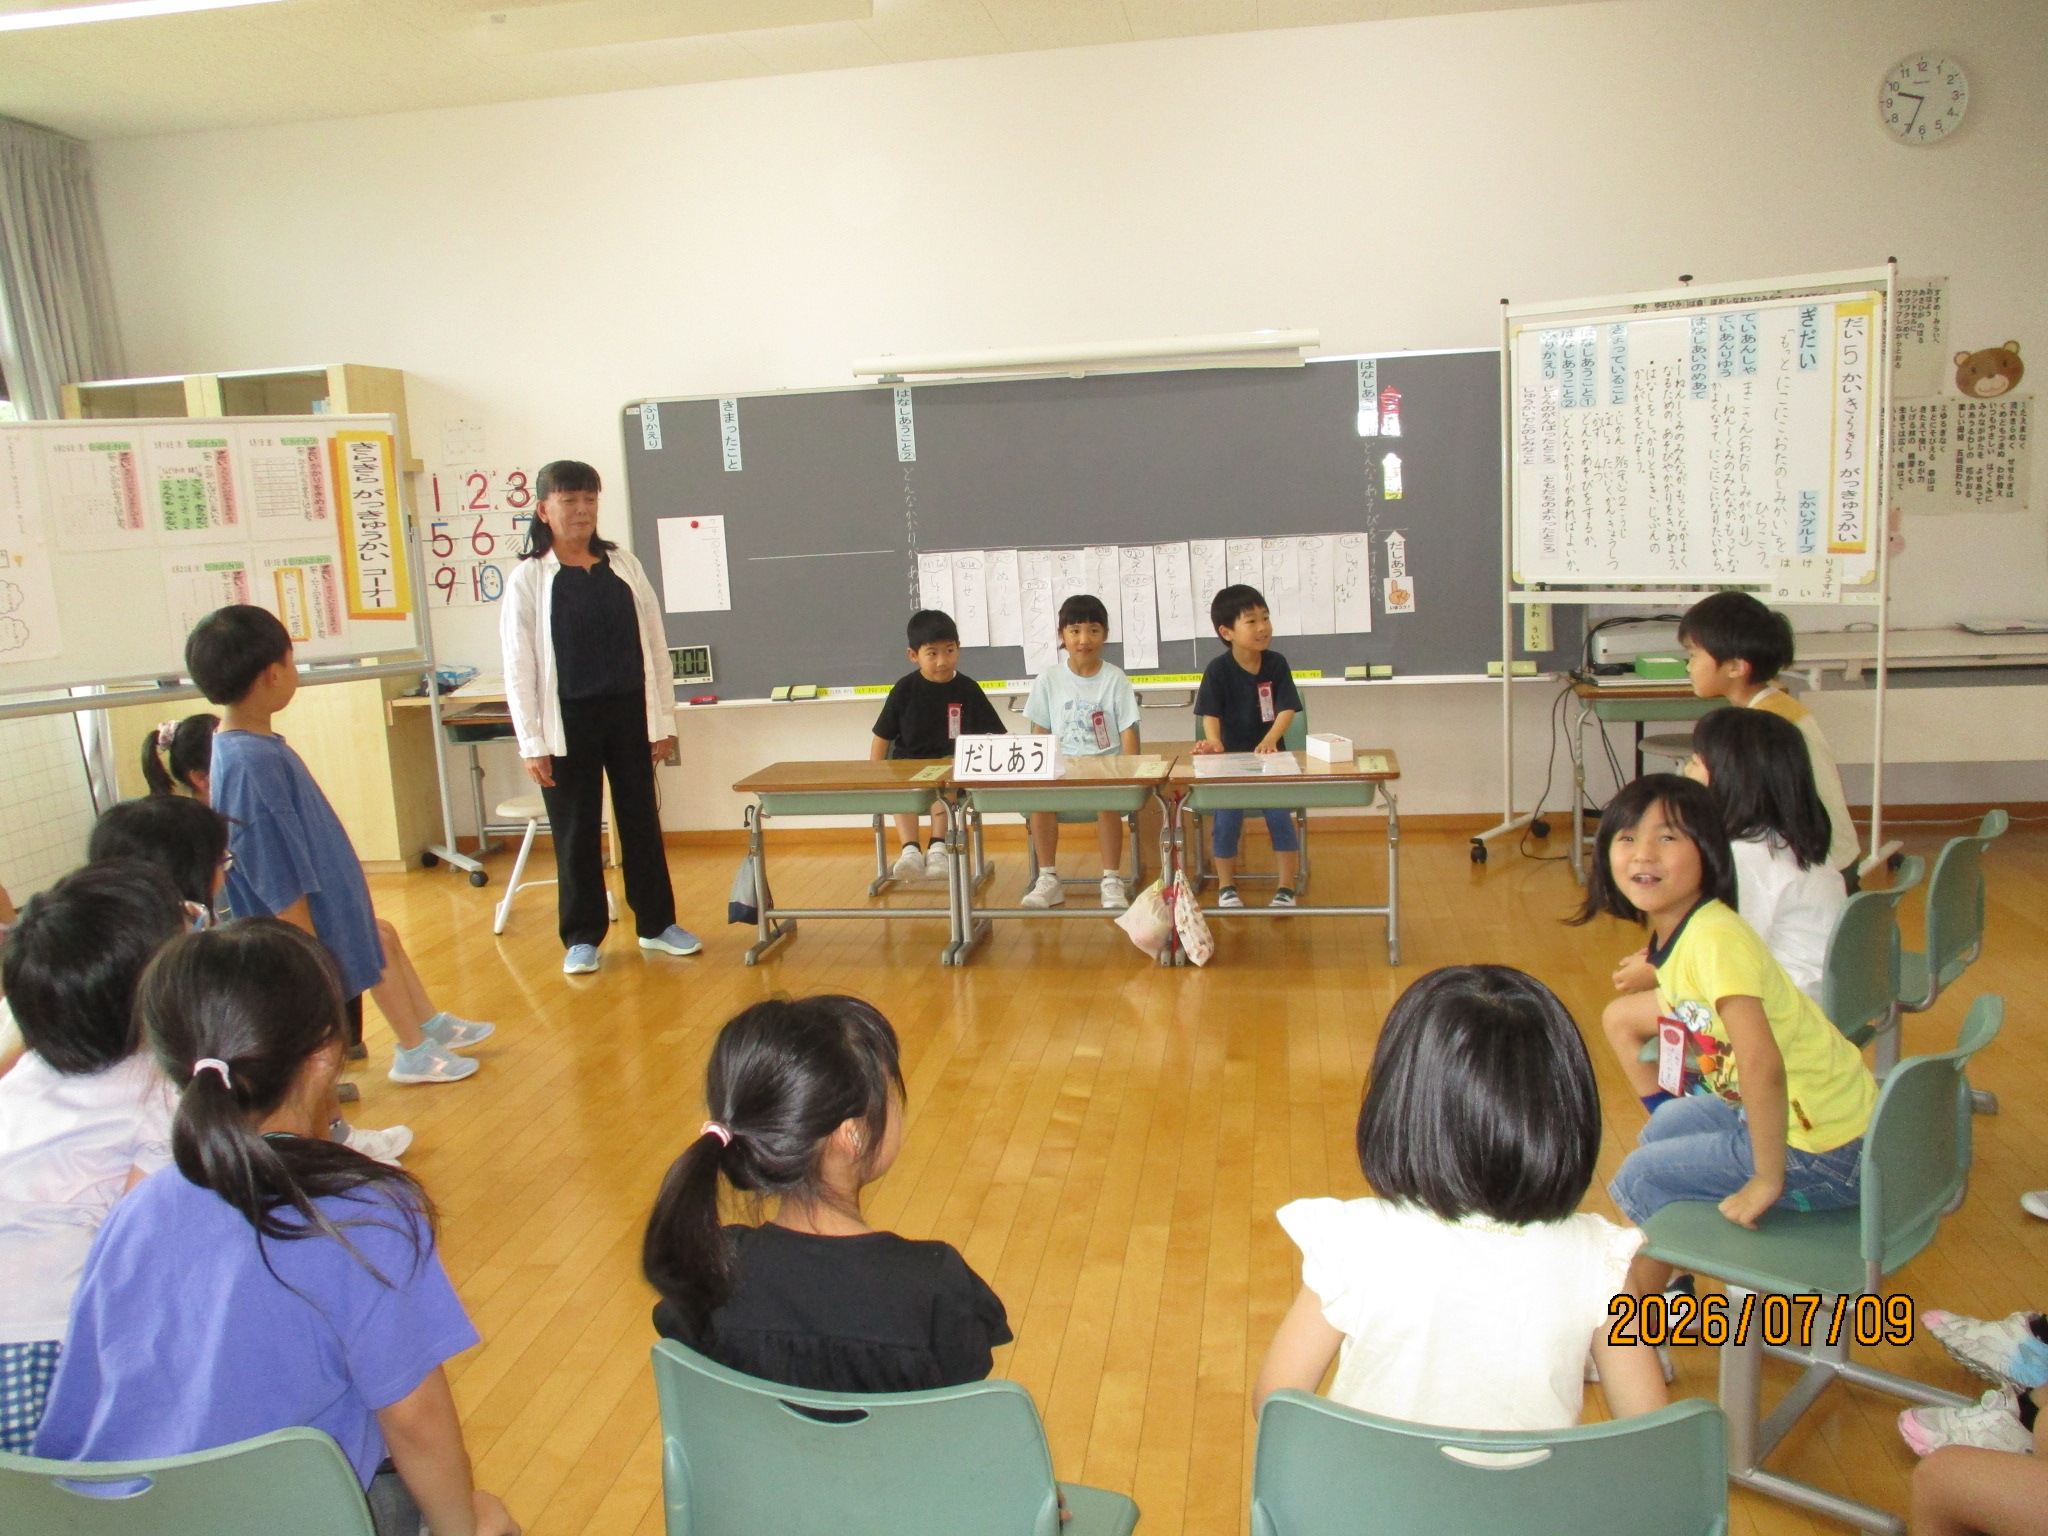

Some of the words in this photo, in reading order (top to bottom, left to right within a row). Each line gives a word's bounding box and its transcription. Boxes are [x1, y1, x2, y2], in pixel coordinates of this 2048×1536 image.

[1901, 68, 1910, 78] 11
[1917, 62, 1928, 72] 12
[1936, 65, 1941, 74] 1
[1947, 75, 1954, 85] 2
[1886, 98, 1893, 108] 9
[1889, 81, 1900, 91] 10
[1952, 90, 1959, 100] 3
[1892, 113, 1899, 123] 8
[1919, 125, 1926, 135] 6
[1935, 120, 1942, 130] 5
[1947, 107, 1954, 117] 4
[1543, 331, 1557, 380] ふりかえり
[1800, 307, 1817, 369] ぎだい
[1611, 324, 1626, 405] きまっていること
[1691, 317, 1708, 399] はなしあいのめあて
[644, 406, 658, 448] ふりかえり
[723, 400, 738, 469] きまったこと
[897, 389, 915, 460] はなしあうこと②
[433, 477, 441, 512] 1
[466, 473, 490, 510] 2
[506, 471, 531, 508] 3
[431, 522, 454, 557] 5
[472, 518, 494, 556] 6
[1800, 491, 1816, 553] しかいグループ
[1390, 541, 1404, 577] だしあう
[362, 568, 392, 608] コーナー
[435, 566, 456, 603] 9
[472, 565, 504, 601] 10
[965, 742, 1044, 773] だしあう
